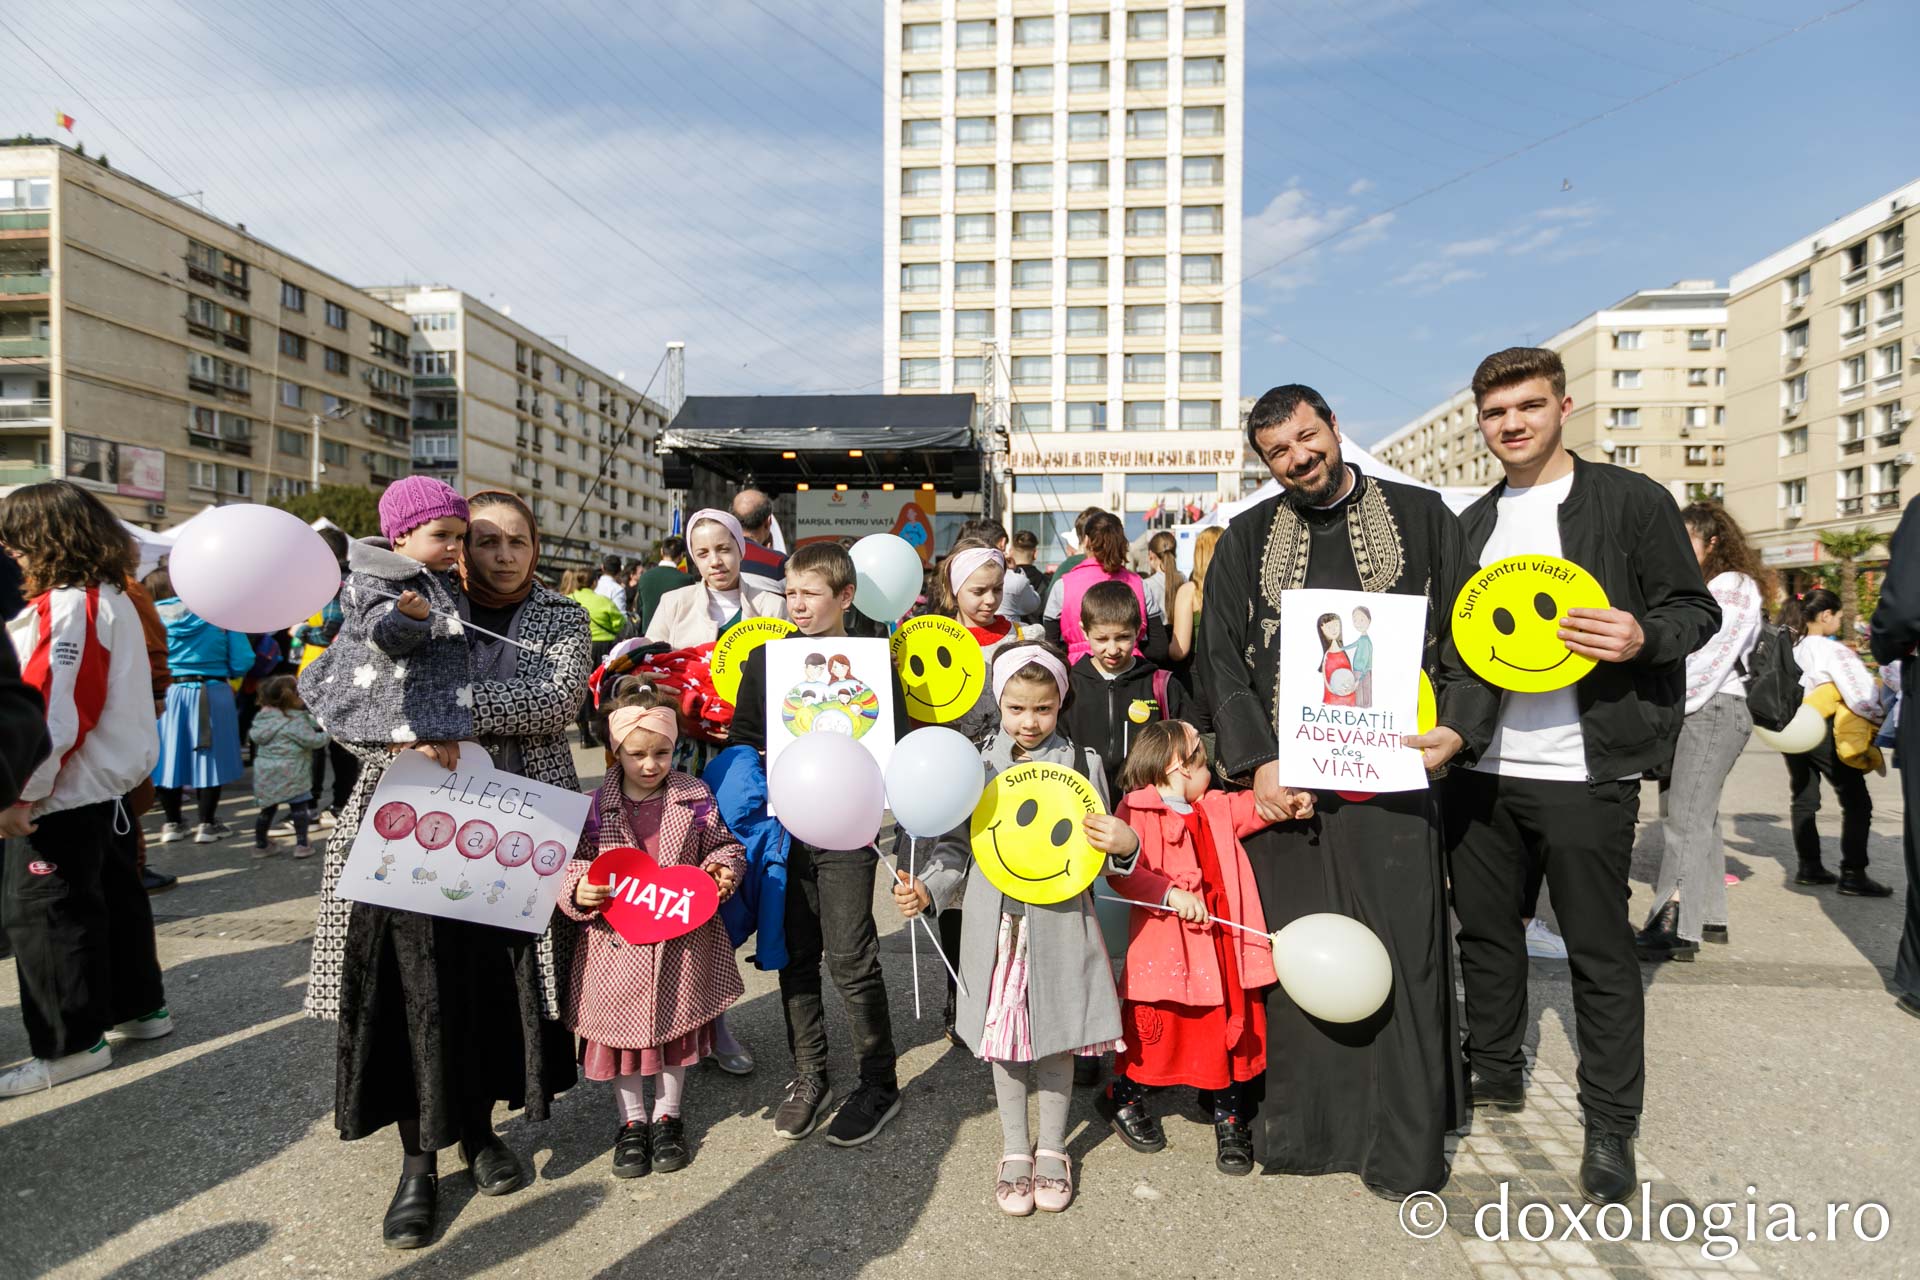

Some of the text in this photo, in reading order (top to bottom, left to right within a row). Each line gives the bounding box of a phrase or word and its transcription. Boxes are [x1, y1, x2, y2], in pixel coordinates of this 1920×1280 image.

[798, 517, 895, 528] MARȘUL PENTRU VIAȚĂ
[1459, 560, 1577, 620] Sunt pentru viață!
[715, 620, 788, 675] Sunt pentru viață!
[900, 620, 933, 641] pentru
[936, 621, 966, 642] viață!
[1331, 745, 1365, 762] aleg
[430, 771, 542, 820] ALEGE
[1005, 767, 1038, 788] Sunt
[1041, 768, 1085, 796] pentru
[608, 872, 696, 925] VIAȚĂ
